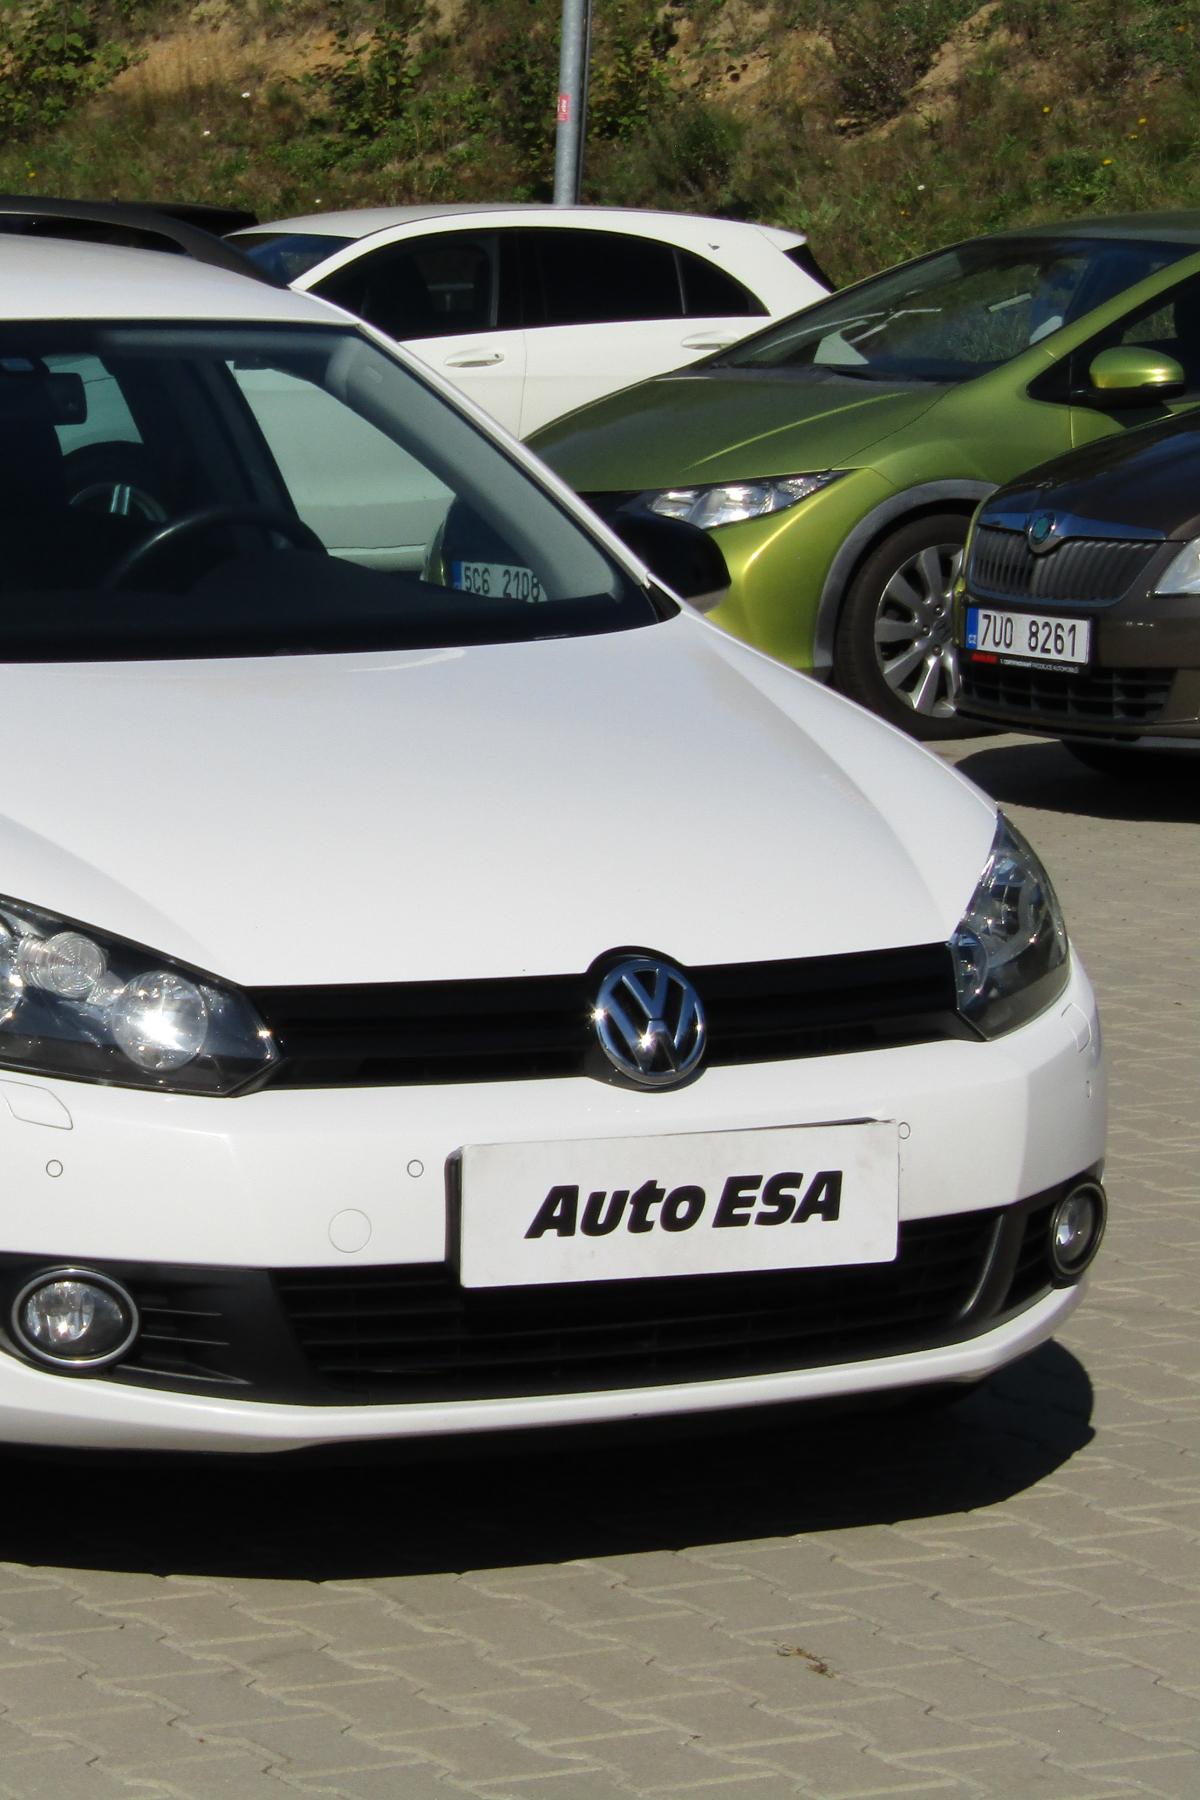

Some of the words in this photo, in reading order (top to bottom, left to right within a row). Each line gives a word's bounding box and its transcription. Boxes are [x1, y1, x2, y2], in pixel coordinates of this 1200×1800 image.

[464, 565, 491, 595] 5C6
[502, 569, 541, 602] 2108
[1028, 620, 1077, 657] 8261
[523, 1180, 706, 1239] Auto
[711, 1170, 844, 1229] ESA
